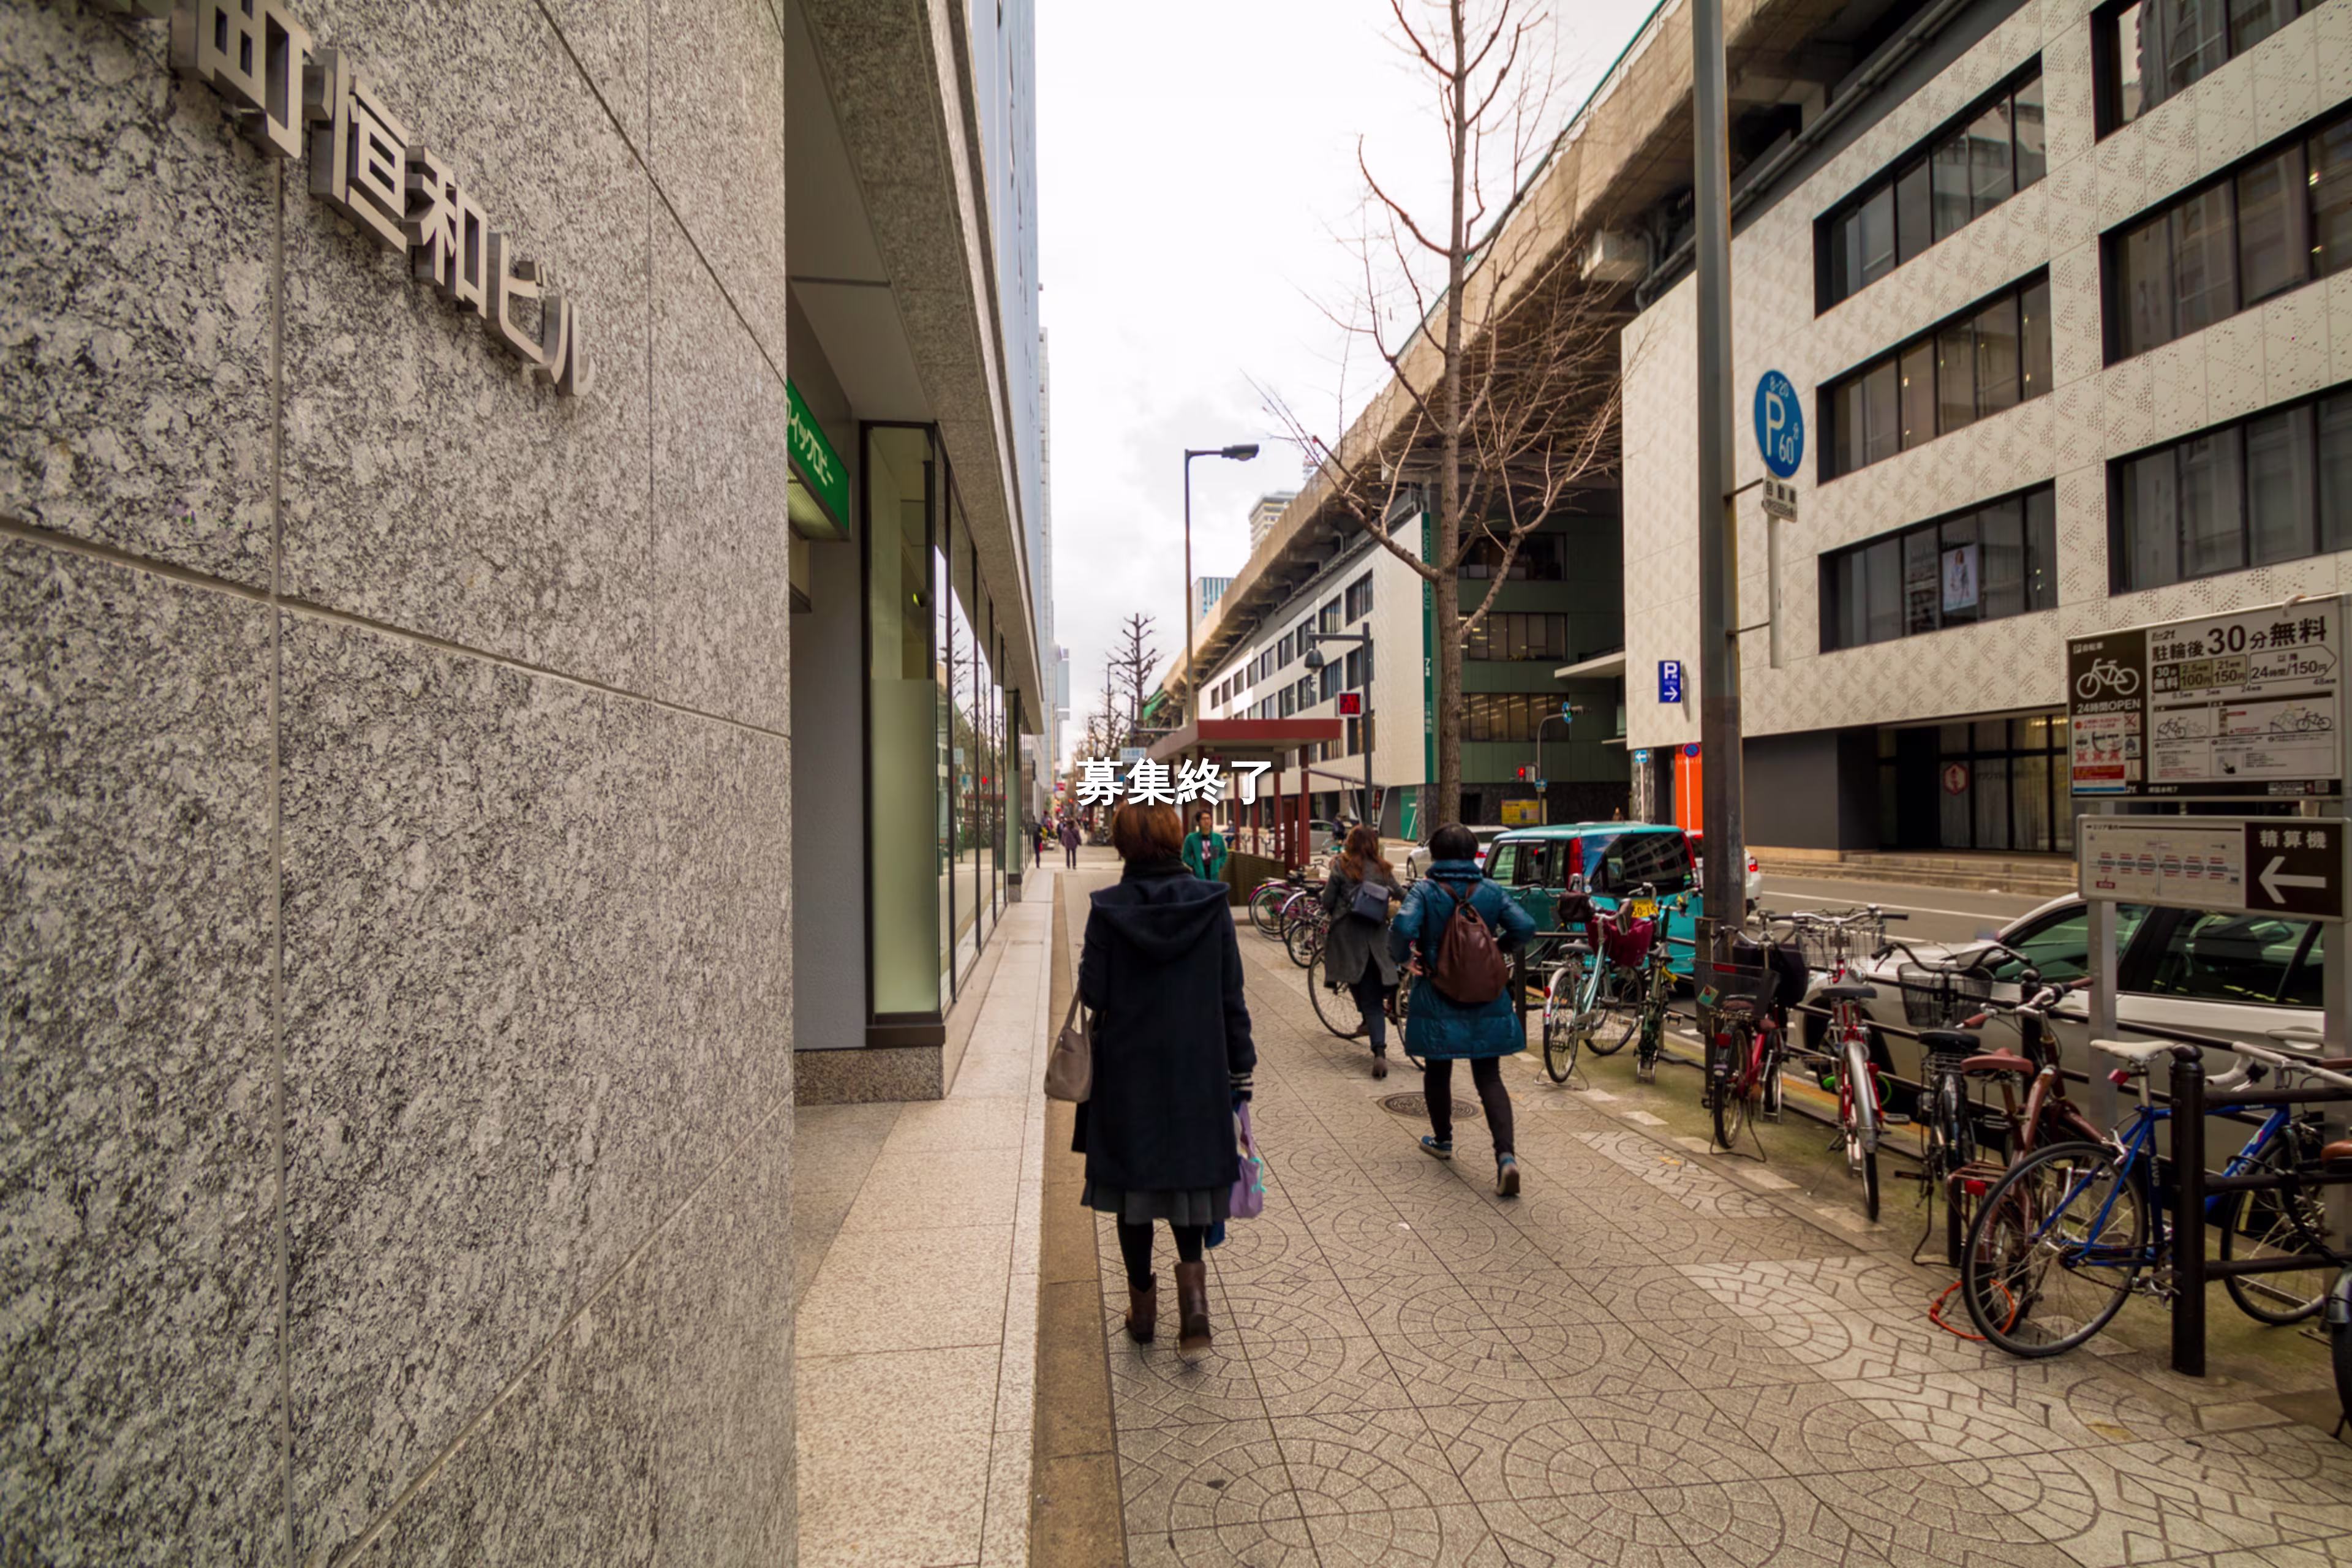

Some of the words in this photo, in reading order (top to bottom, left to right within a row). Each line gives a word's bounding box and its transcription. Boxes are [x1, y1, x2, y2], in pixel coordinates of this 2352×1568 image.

[1770, 375, 1789, 398] 8-20
[1765, 391, 1785, 457] P
[2152, 616, 2328, 662] 駐輪後30分無料
[1664, 662, 1678, 679] P
[2214, 669, 2245, 684] 150円
[2180, 674, 2212, 687] 100円
[2077, 698, 2141, 714] 24時間OPEN
[2259, 830, 2327, 850] 精算機
